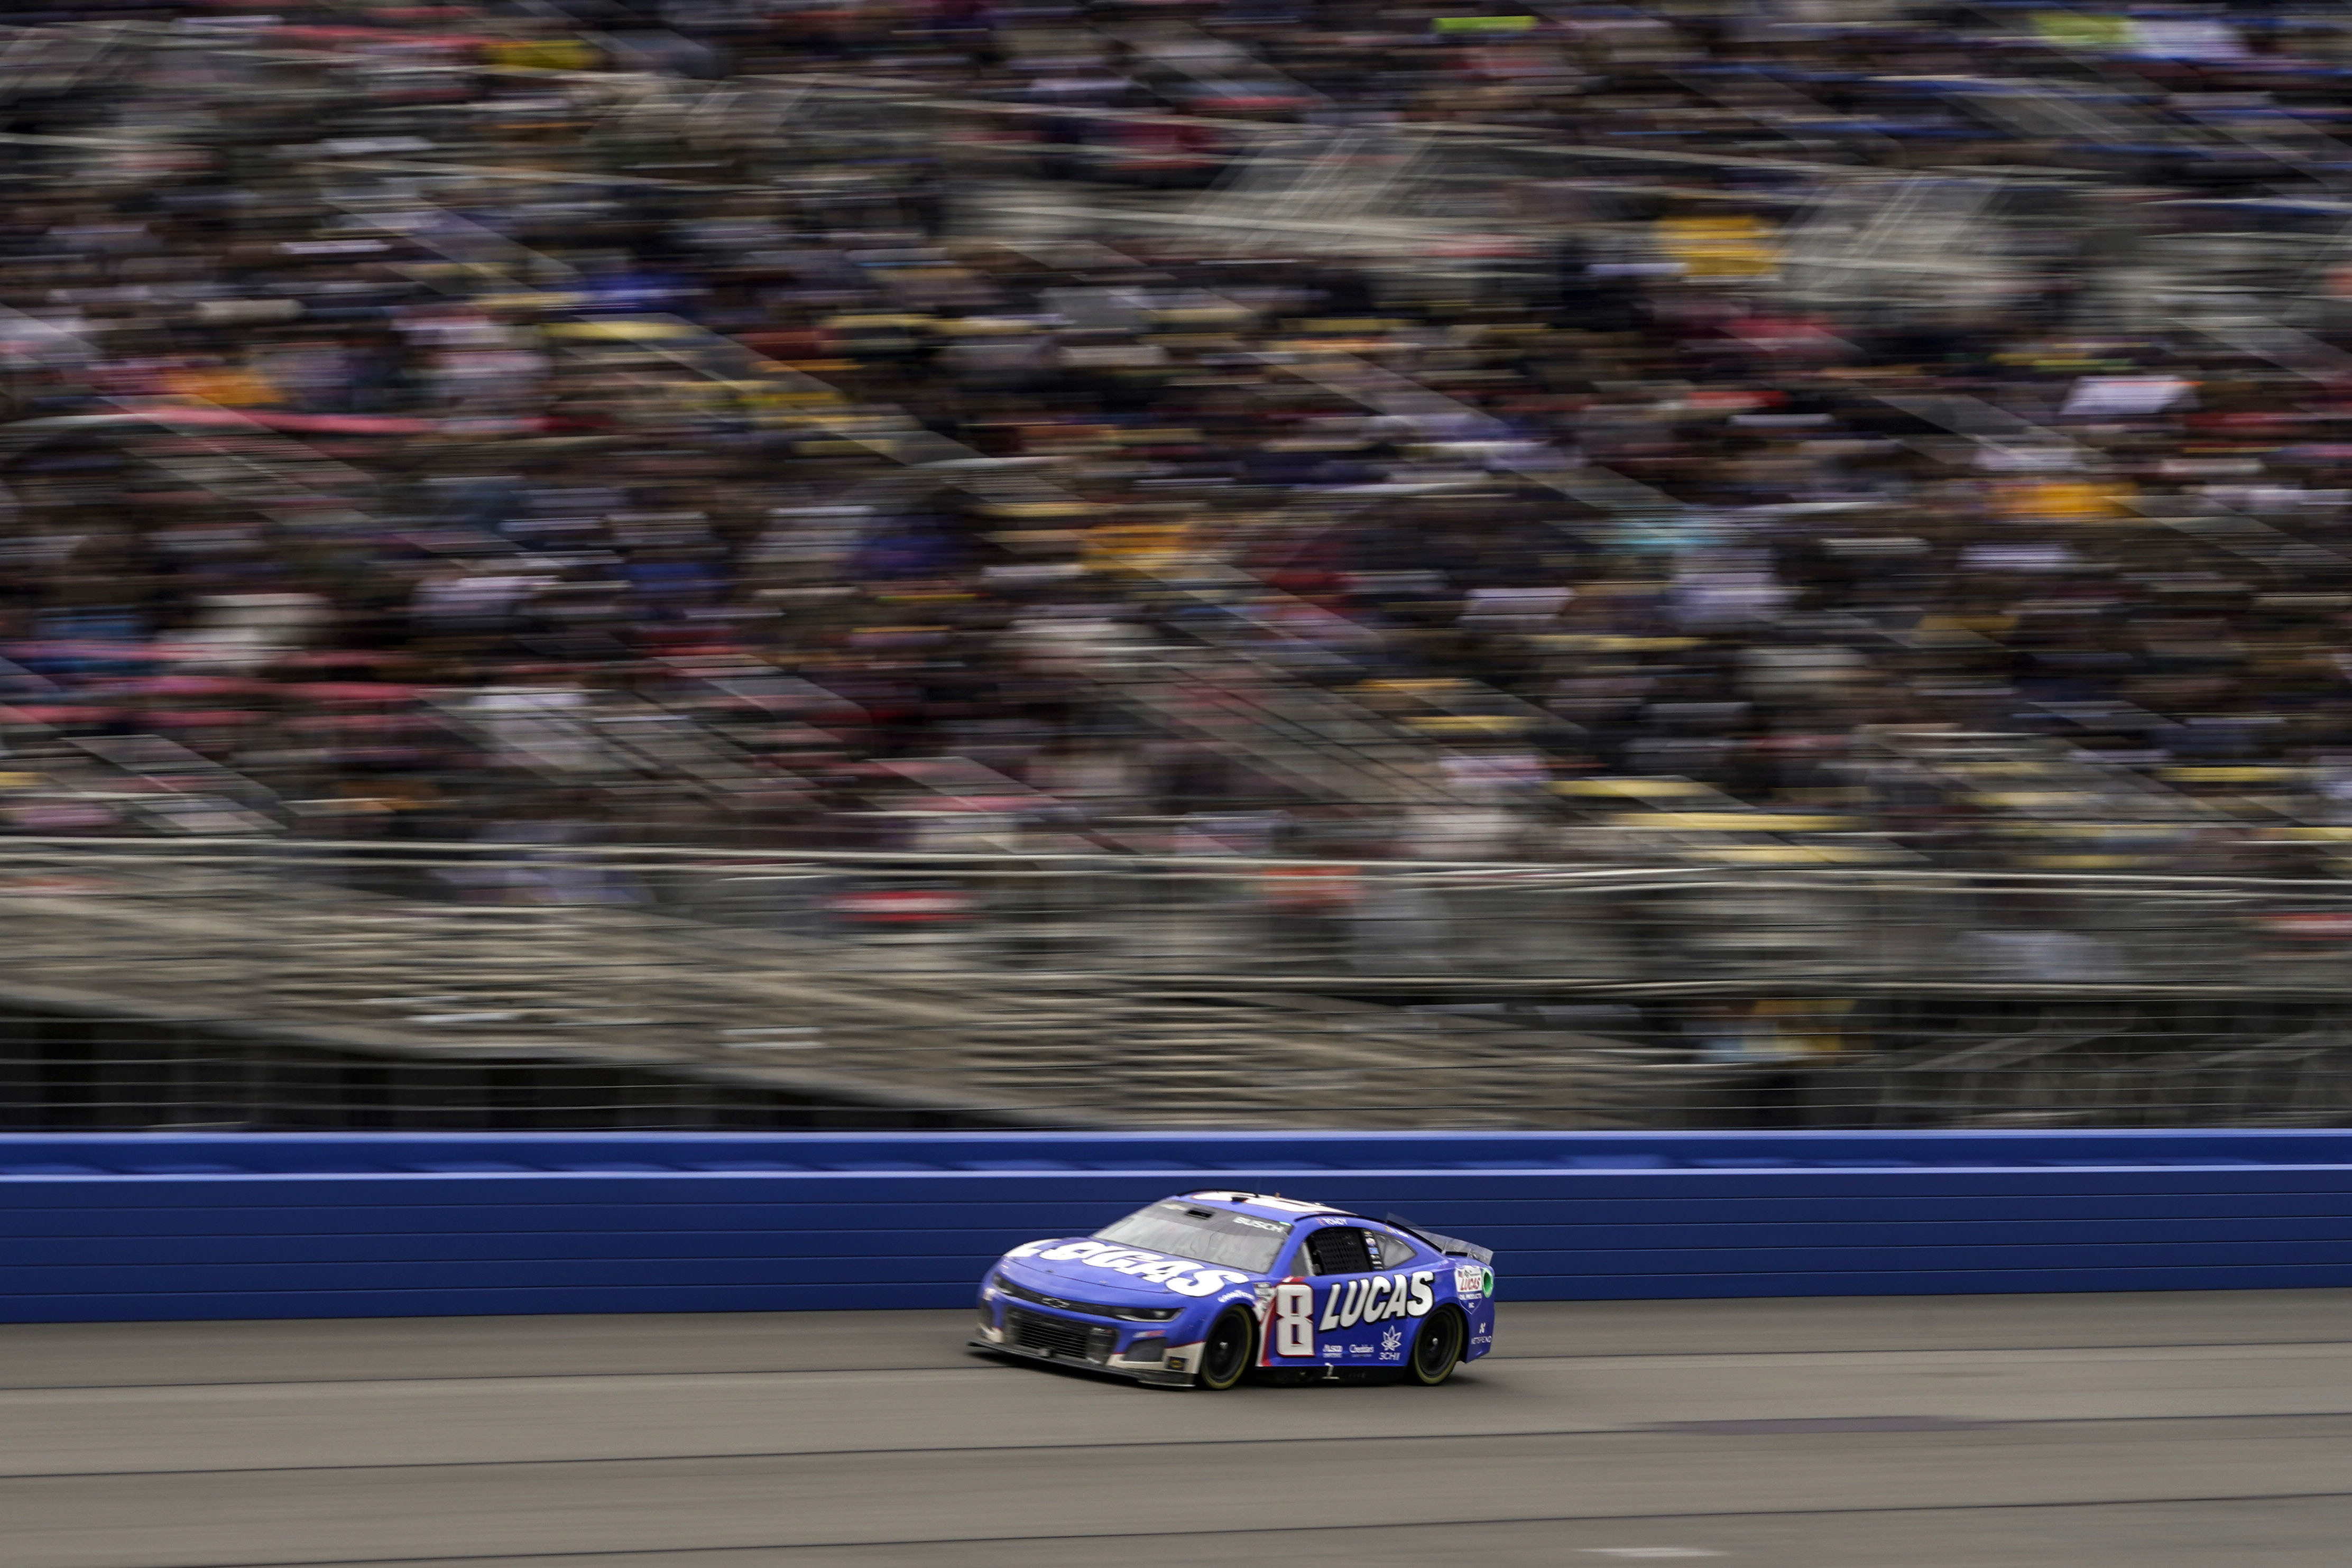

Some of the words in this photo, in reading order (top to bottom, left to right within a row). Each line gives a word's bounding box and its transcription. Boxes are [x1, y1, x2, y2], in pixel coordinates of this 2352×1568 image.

[1232, 1216, 1284, 1233] BUSCH
[1004, 1238, 1250, 1297] LUCAS
[1460, 1277, 1481, 1290] LUCAS
[1318, 1270, 1434, 1331] LUCAS
[1276, 1284, 1315, 1357] 8
[1379, 1352, 1400, 1360] 3CHI
